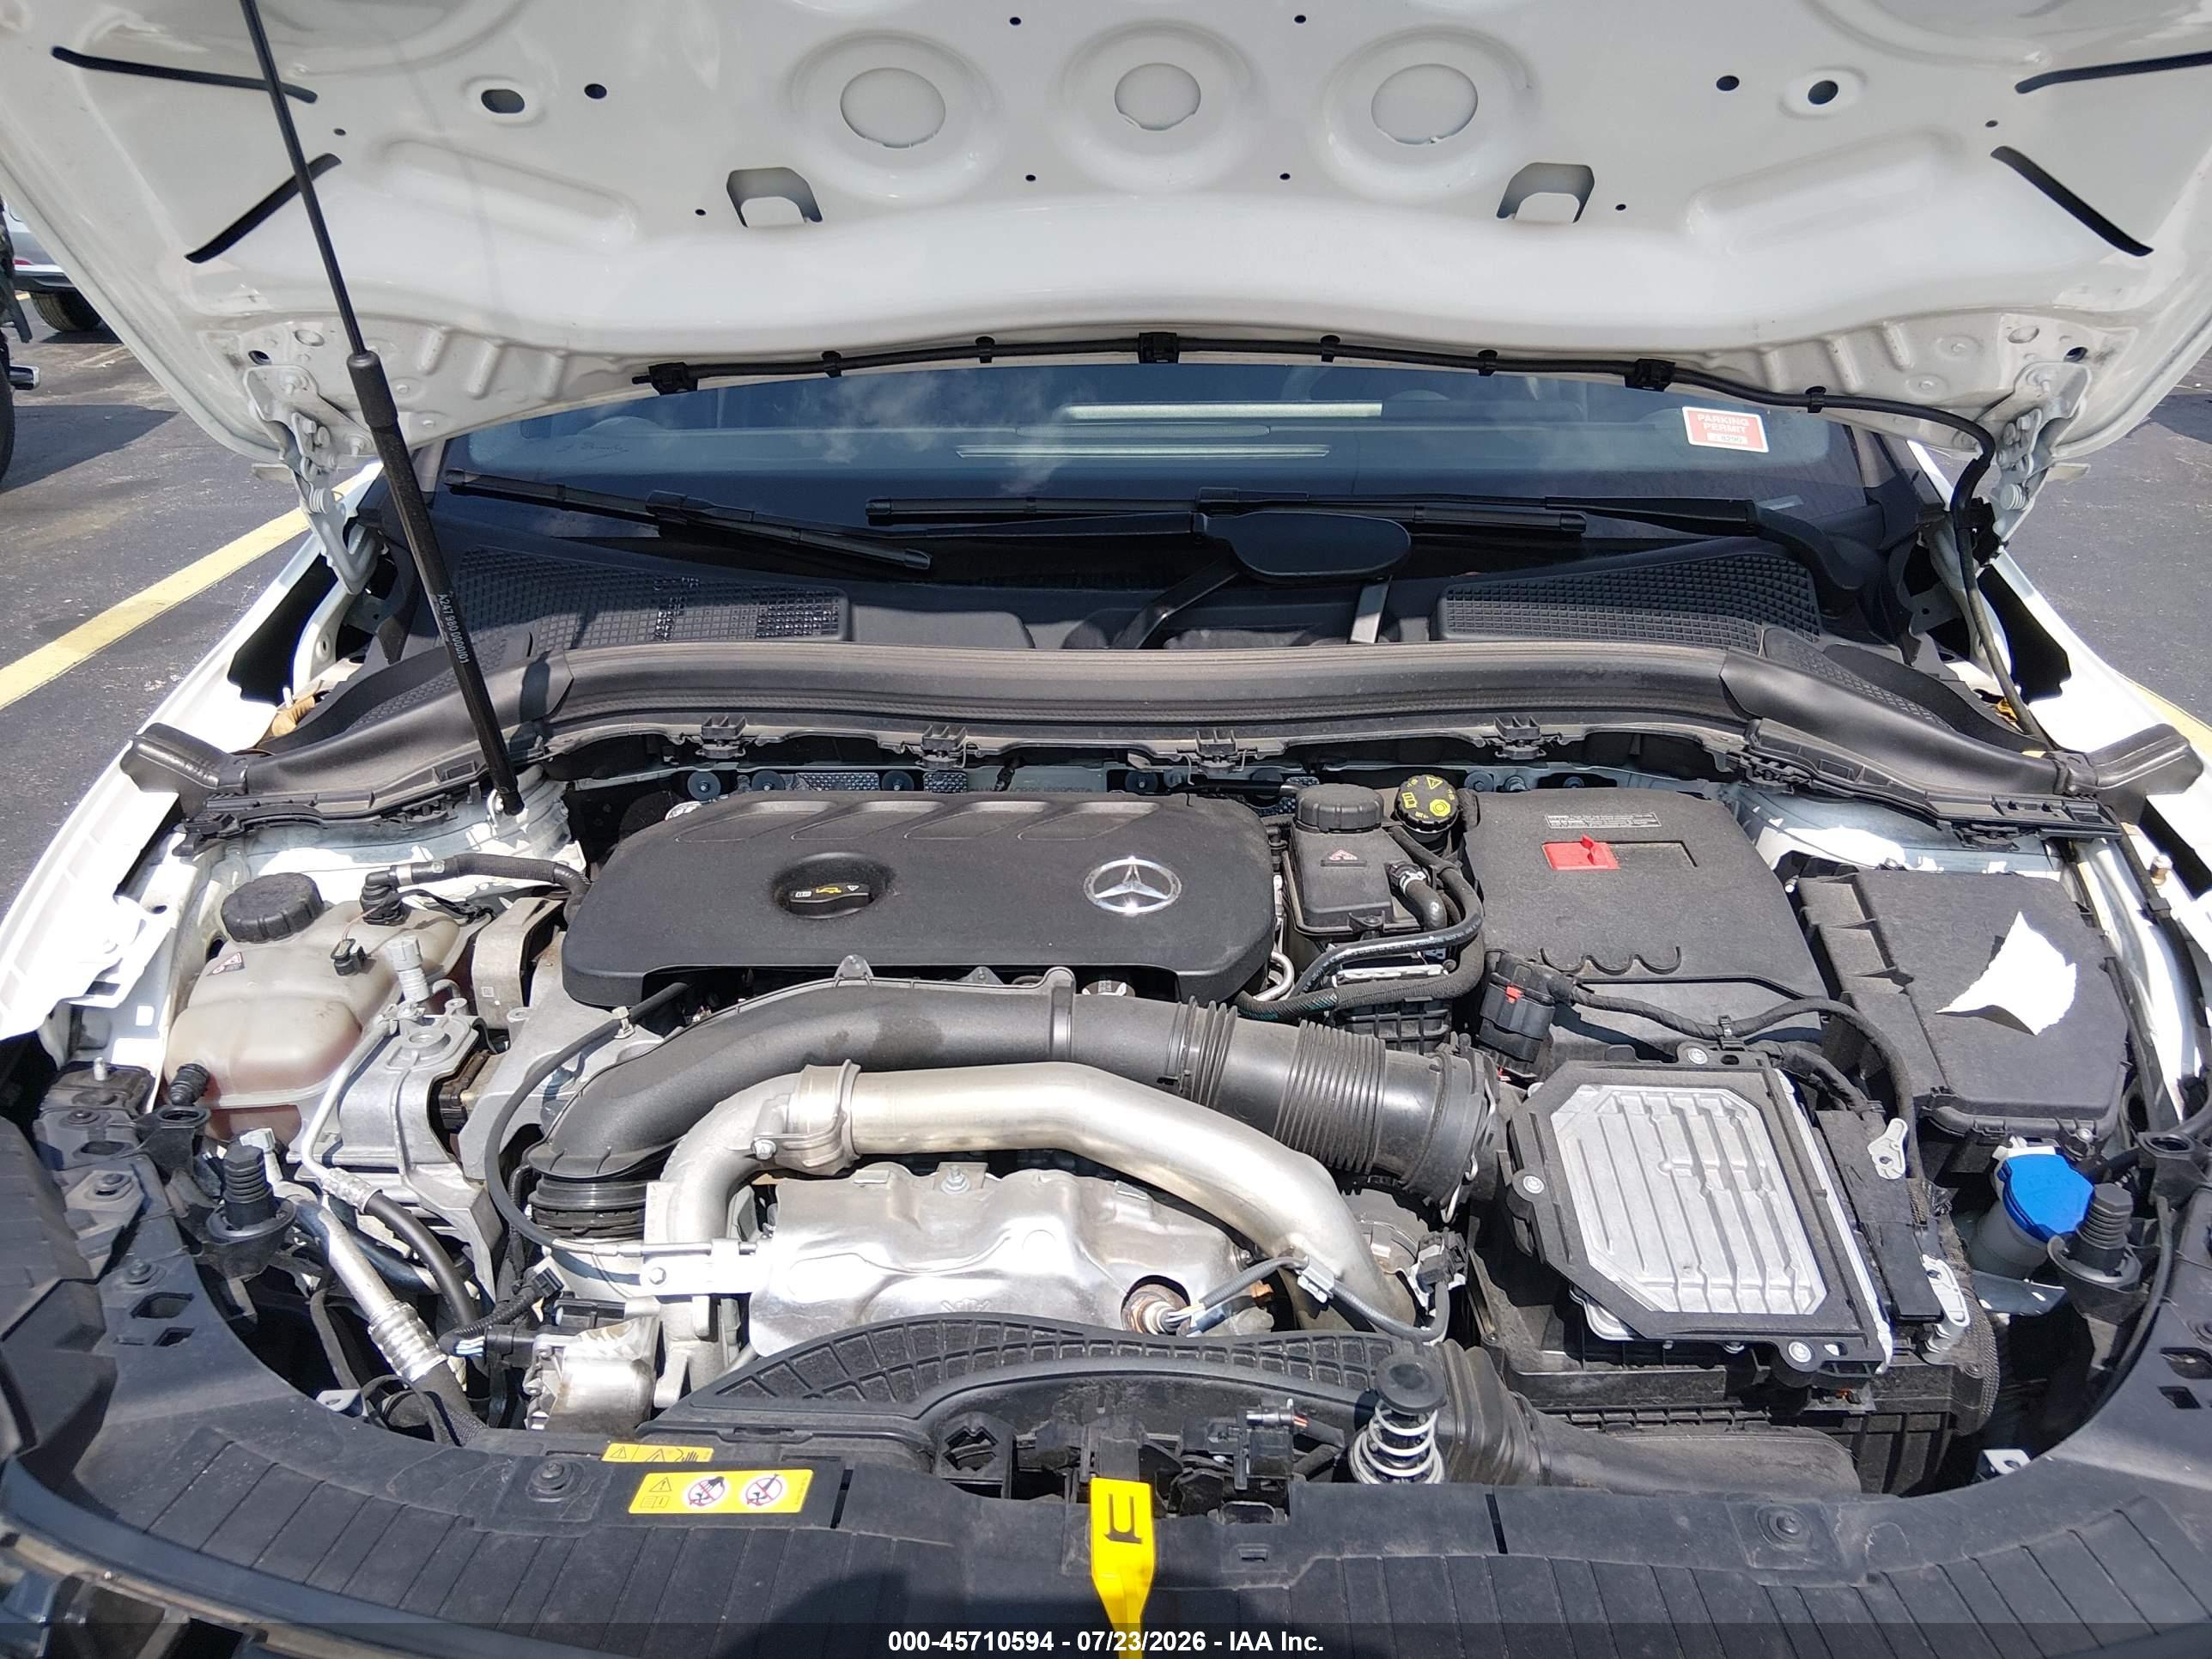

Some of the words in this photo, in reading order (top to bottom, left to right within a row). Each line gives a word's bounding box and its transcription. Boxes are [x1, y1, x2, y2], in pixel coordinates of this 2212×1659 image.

[1696, 413, 1750, 427] PARKING
[1703, 422, 1747, 434] PERMIT
[437, 593, 454, 614] A247
